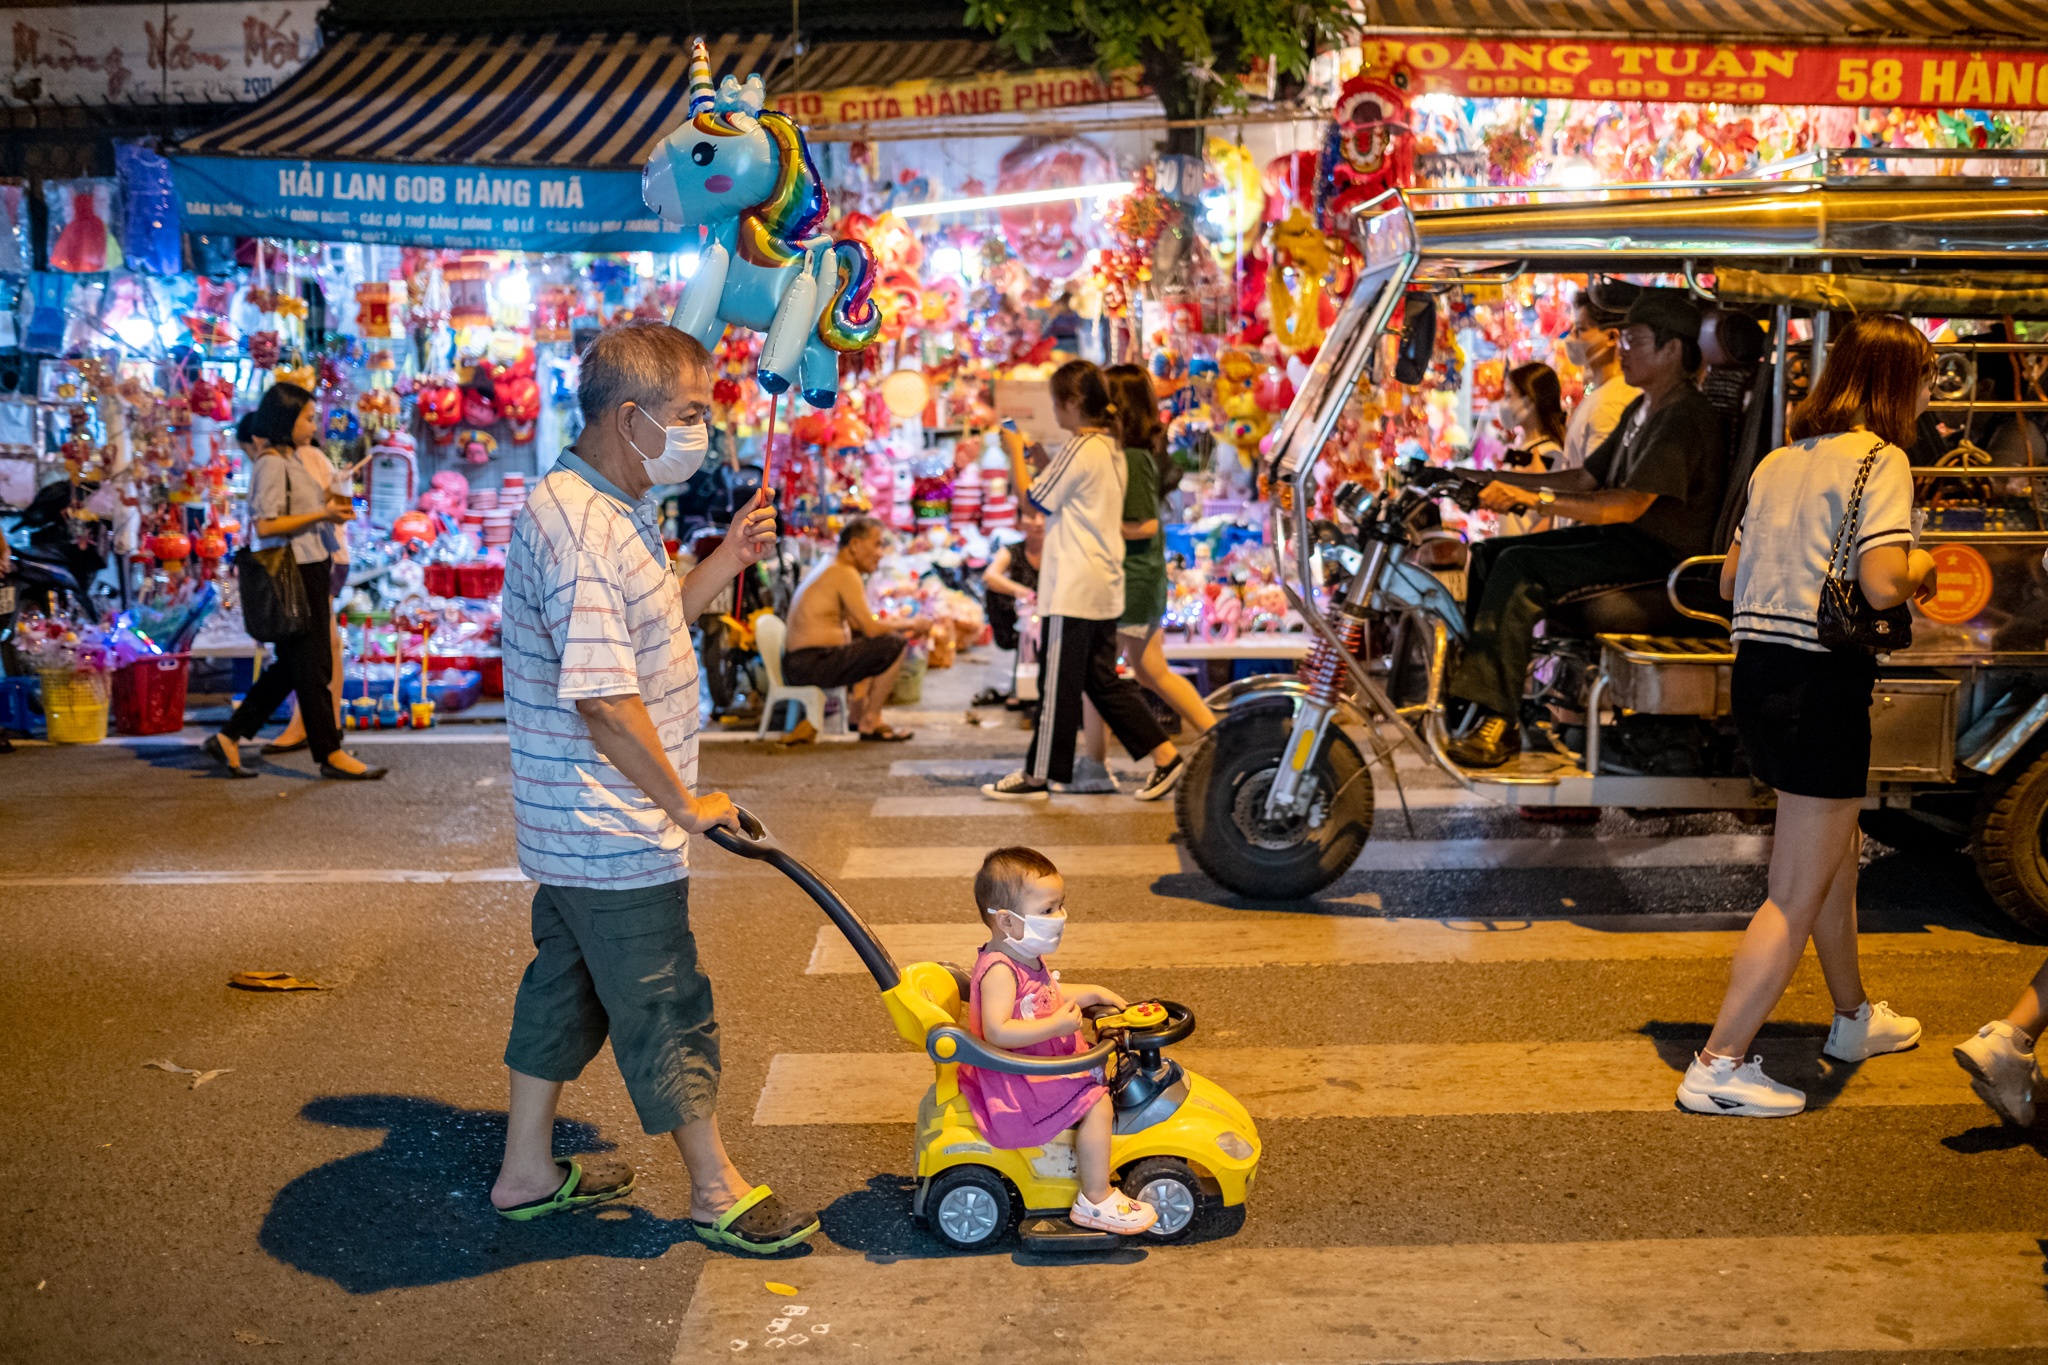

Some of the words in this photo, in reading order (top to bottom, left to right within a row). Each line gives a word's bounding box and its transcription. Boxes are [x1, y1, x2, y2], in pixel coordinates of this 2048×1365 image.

[1467, 75, 1575, 95] 0905
[1683, 80, 1766, 100] 529
[1836, 58, 1904, 101] 58
[1920, 51, 2048, 105] HÀN
[278, 161, 325, 198] HẢI
[332, 172, 387, 202] LAN
[394, 175, 446, 204] 60B
[539, 175, 585, 210] MÃ
